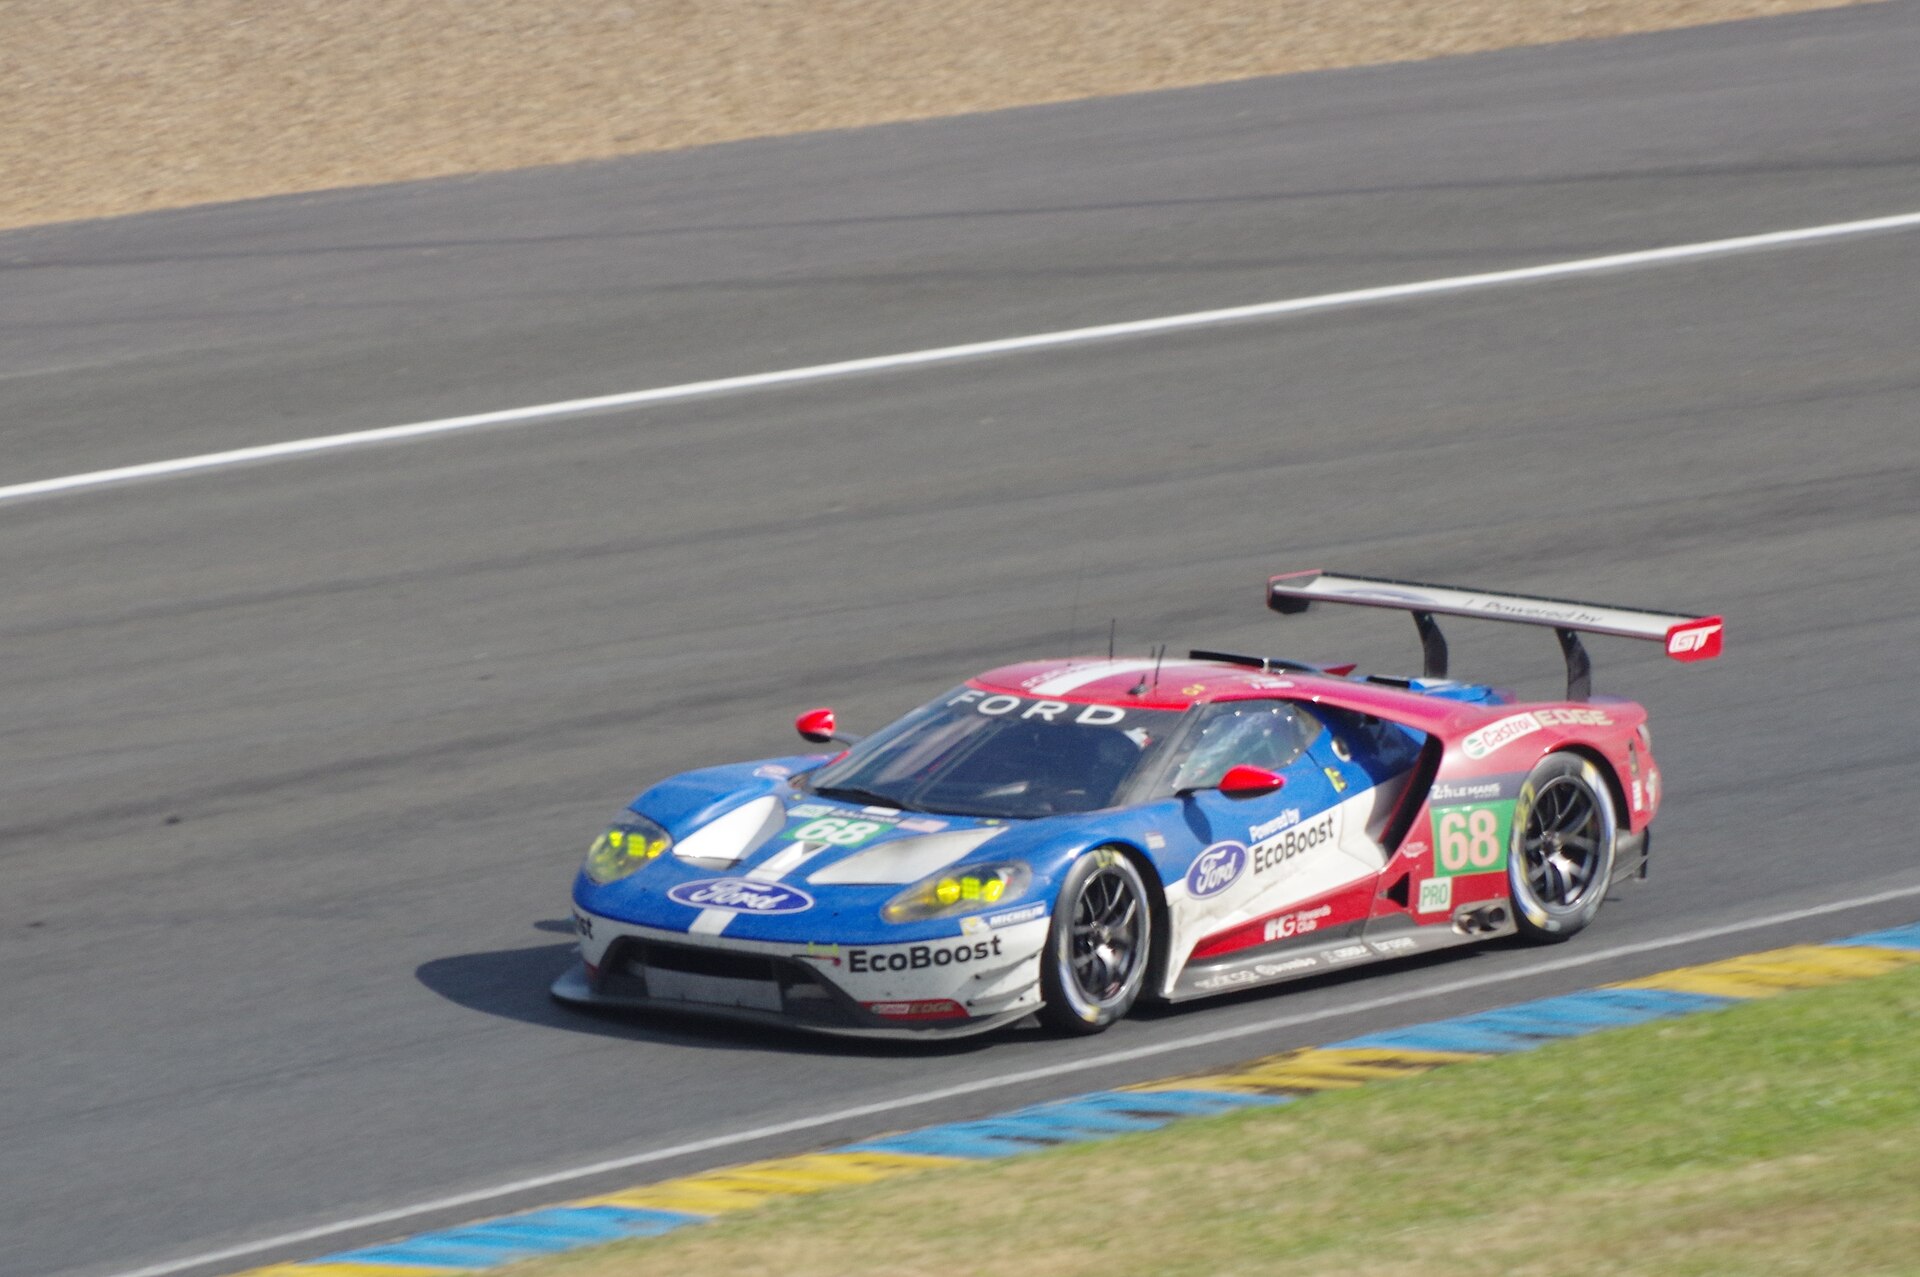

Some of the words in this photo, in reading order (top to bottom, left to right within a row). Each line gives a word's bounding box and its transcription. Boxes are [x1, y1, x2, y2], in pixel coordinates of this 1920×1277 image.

[1668, 624, 1723, 653] GT
[946, 689, 1127, 726] FORD
[1481, 716, 1534, 748] Castrol
[1533, 708, 1615, 727] EDGE
[794, 817, 881, 845] 68
[1253, 814, 1334, 875] EcoBoost
[1440, 809, 1500, 870] 68
[1194, 848, 1239, 895] Ford
[687, 879, 791, 911] Ford
[1421, 883, 1448, 907] PRO
[989, 904, 1046, 926] MICHELIN
[849, 934, 1002, 974] EcoBoost
